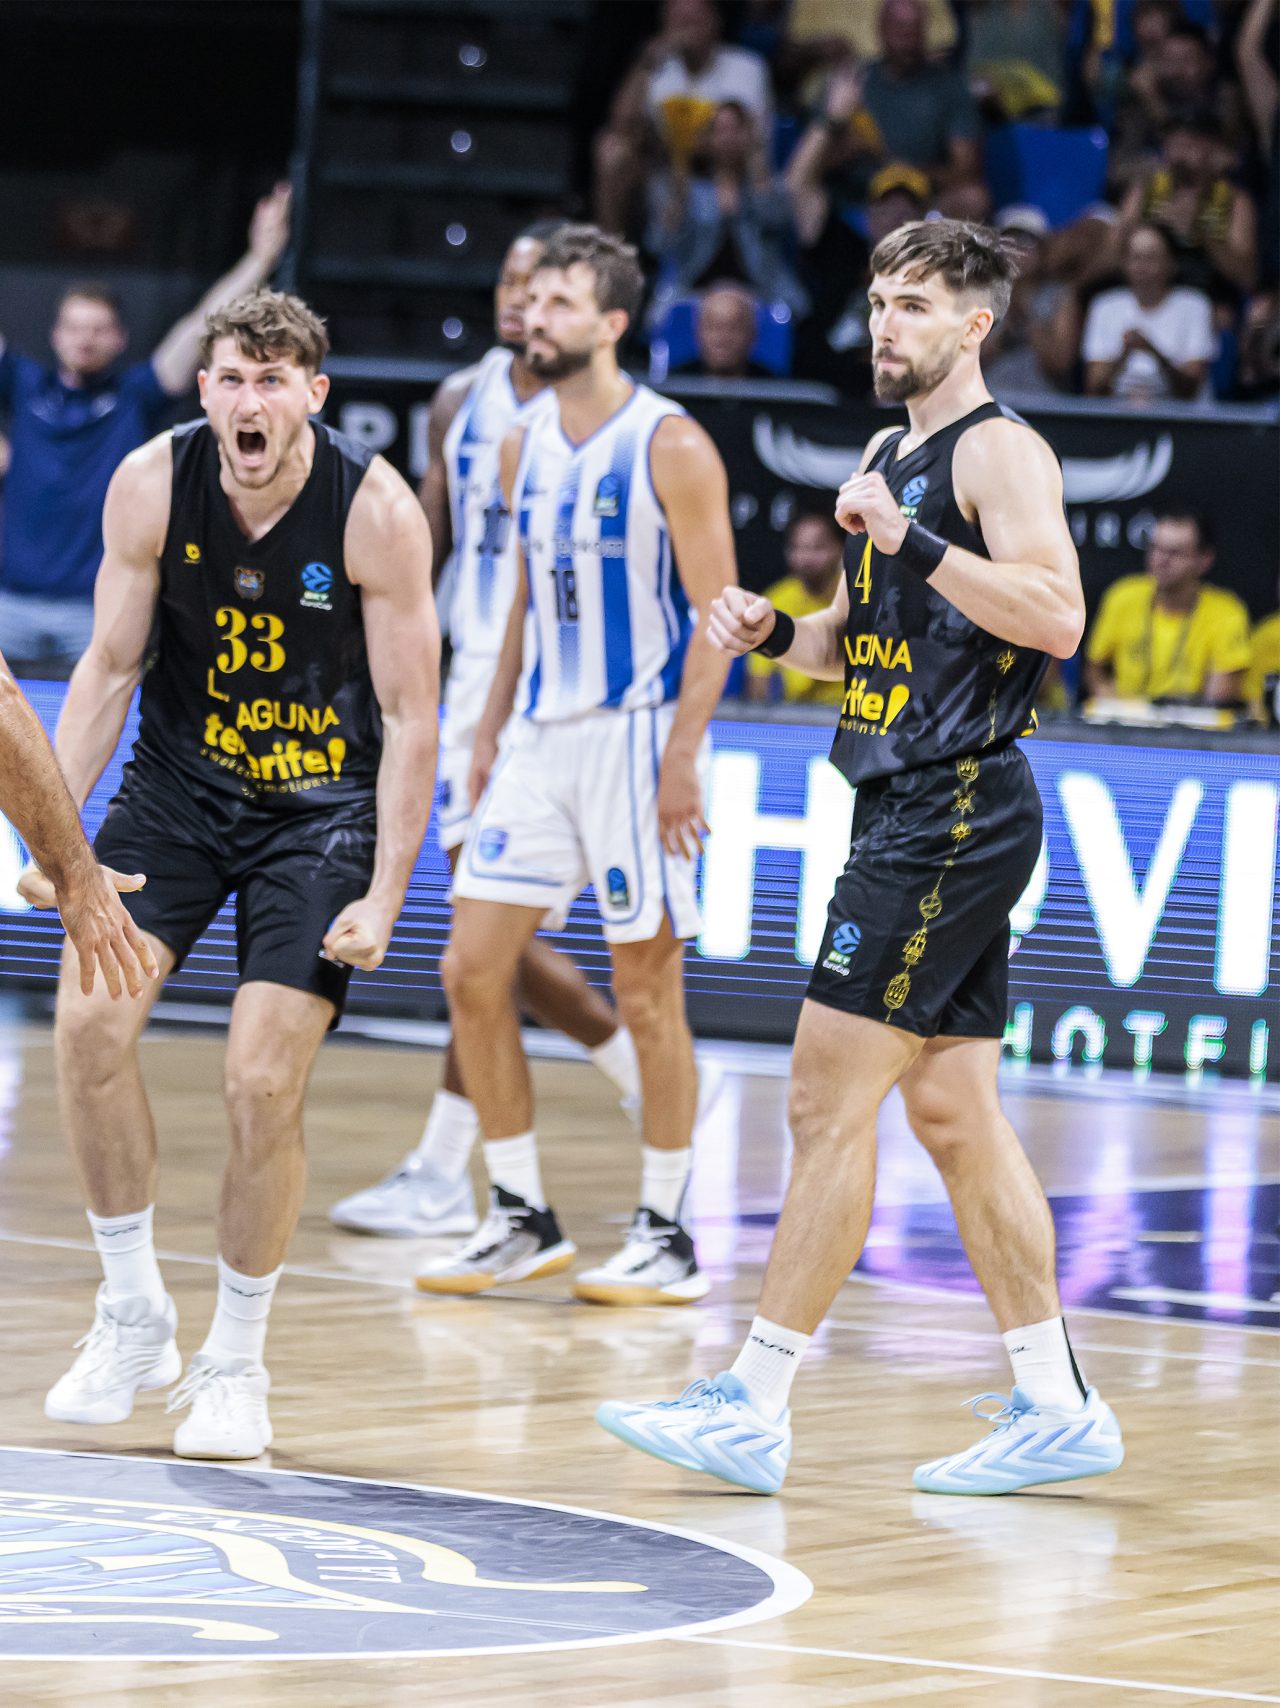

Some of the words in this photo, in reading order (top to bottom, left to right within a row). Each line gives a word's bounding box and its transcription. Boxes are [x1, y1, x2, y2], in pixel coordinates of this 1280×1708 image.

[549, 570, 579, 622] 18
[854, 537, 873, 604] 4
[215, 606, 287, 674] 33
